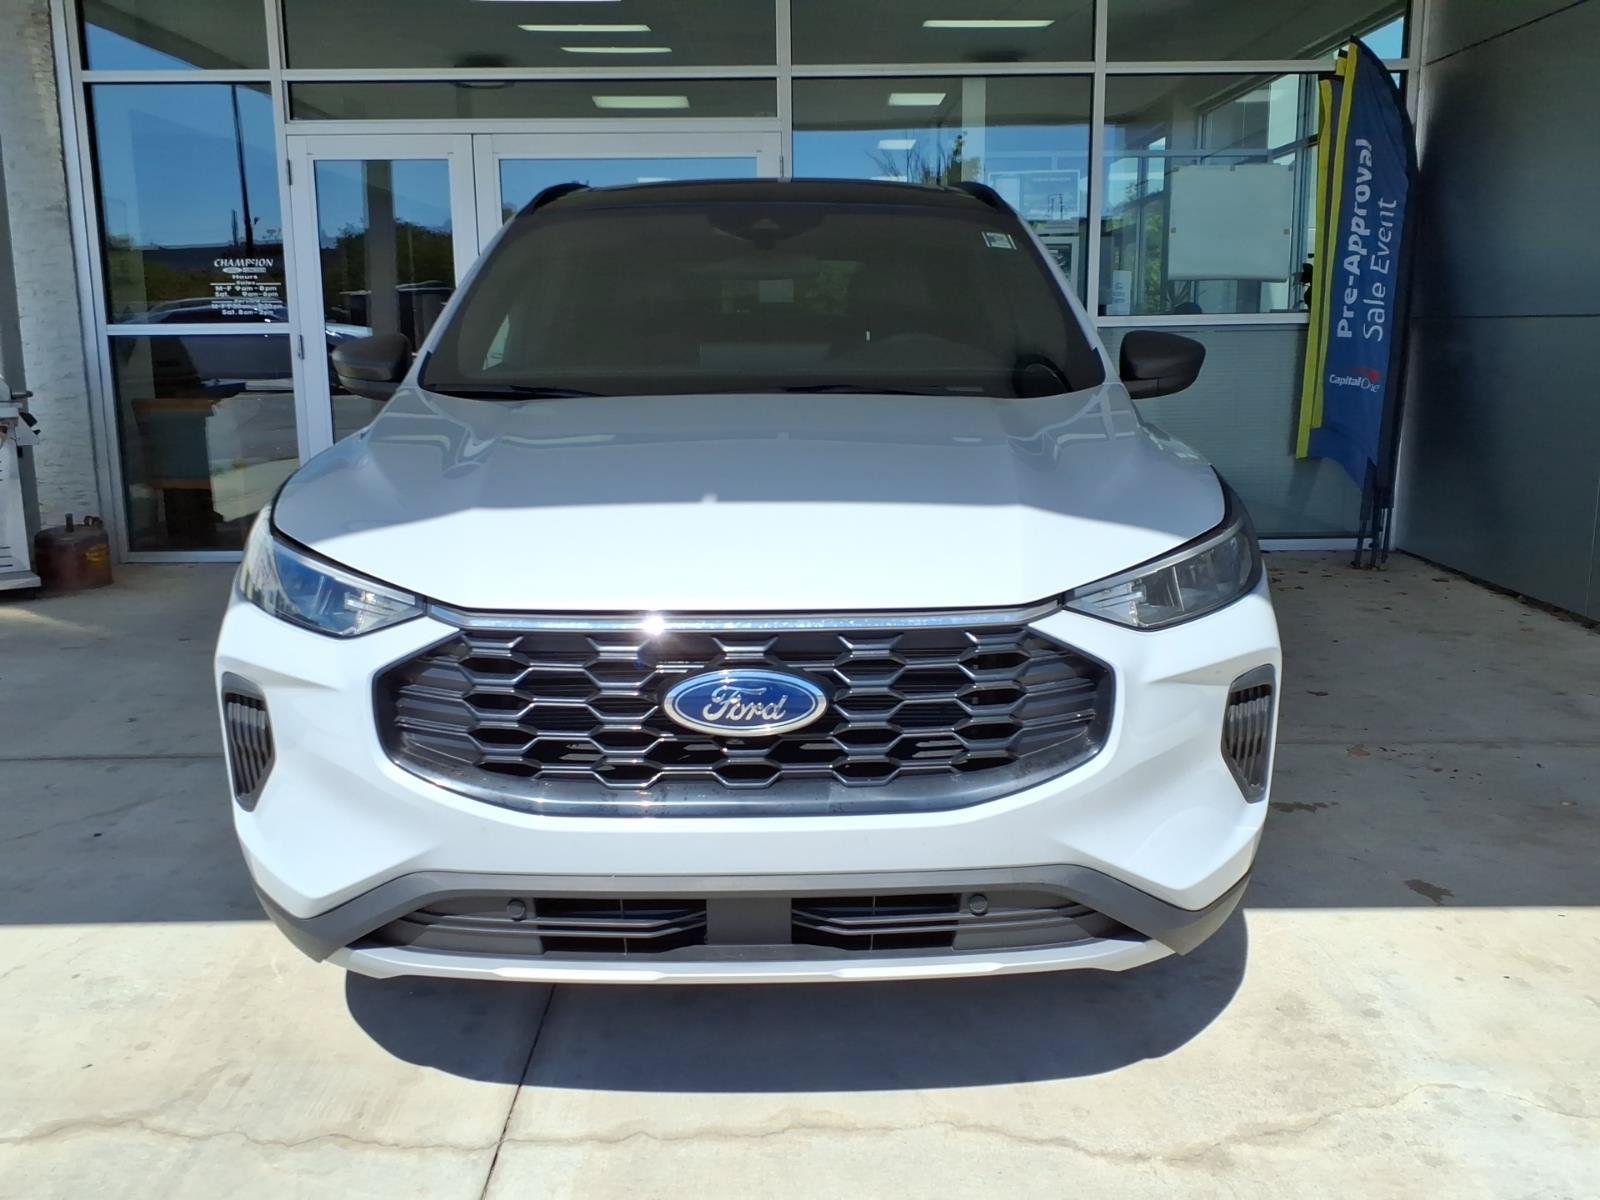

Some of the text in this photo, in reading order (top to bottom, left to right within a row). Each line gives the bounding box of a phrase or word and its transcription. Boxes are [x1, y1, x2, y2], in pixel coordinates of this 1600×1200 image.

[214, 258, 274, 267] CHAMPION
[1337, 138, 1372, 337] Pre-Approval
[1363, 197, 1397, 342] Sale Event
[702, 686, 789, 721] Ford
